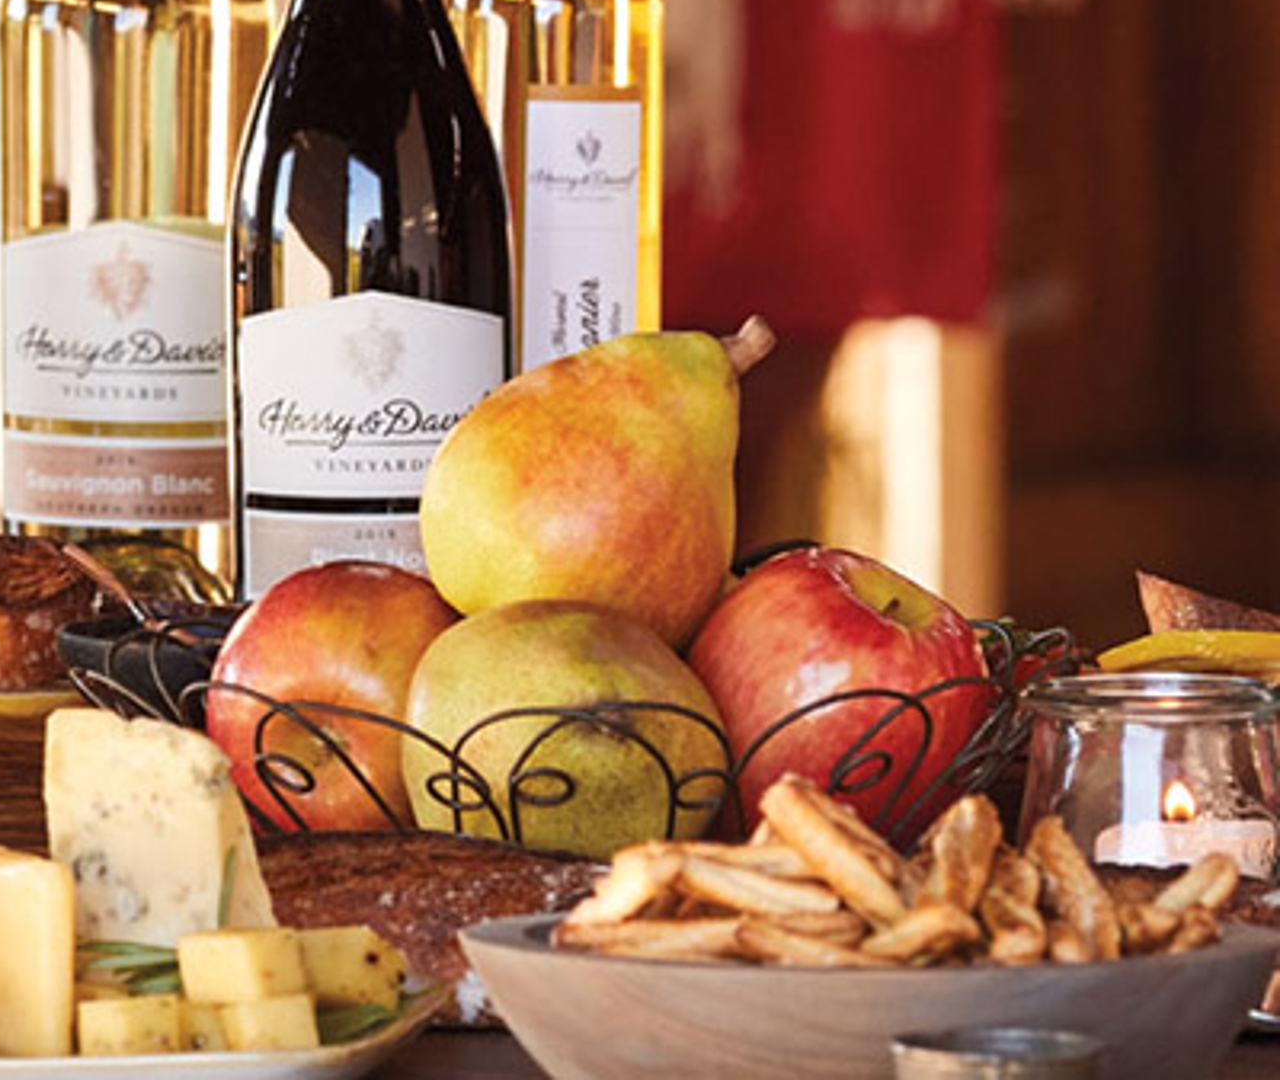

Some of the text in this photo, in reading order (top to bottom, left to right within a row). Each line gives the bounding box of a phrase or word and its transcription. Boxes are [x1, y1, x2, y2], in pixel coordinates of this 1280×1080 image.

[62, 384, 179, 401] VINEYARDS
[312, 457, 432, 474] VINEYARD
[25, 468, 216, 497] Sauvignon Blanc
